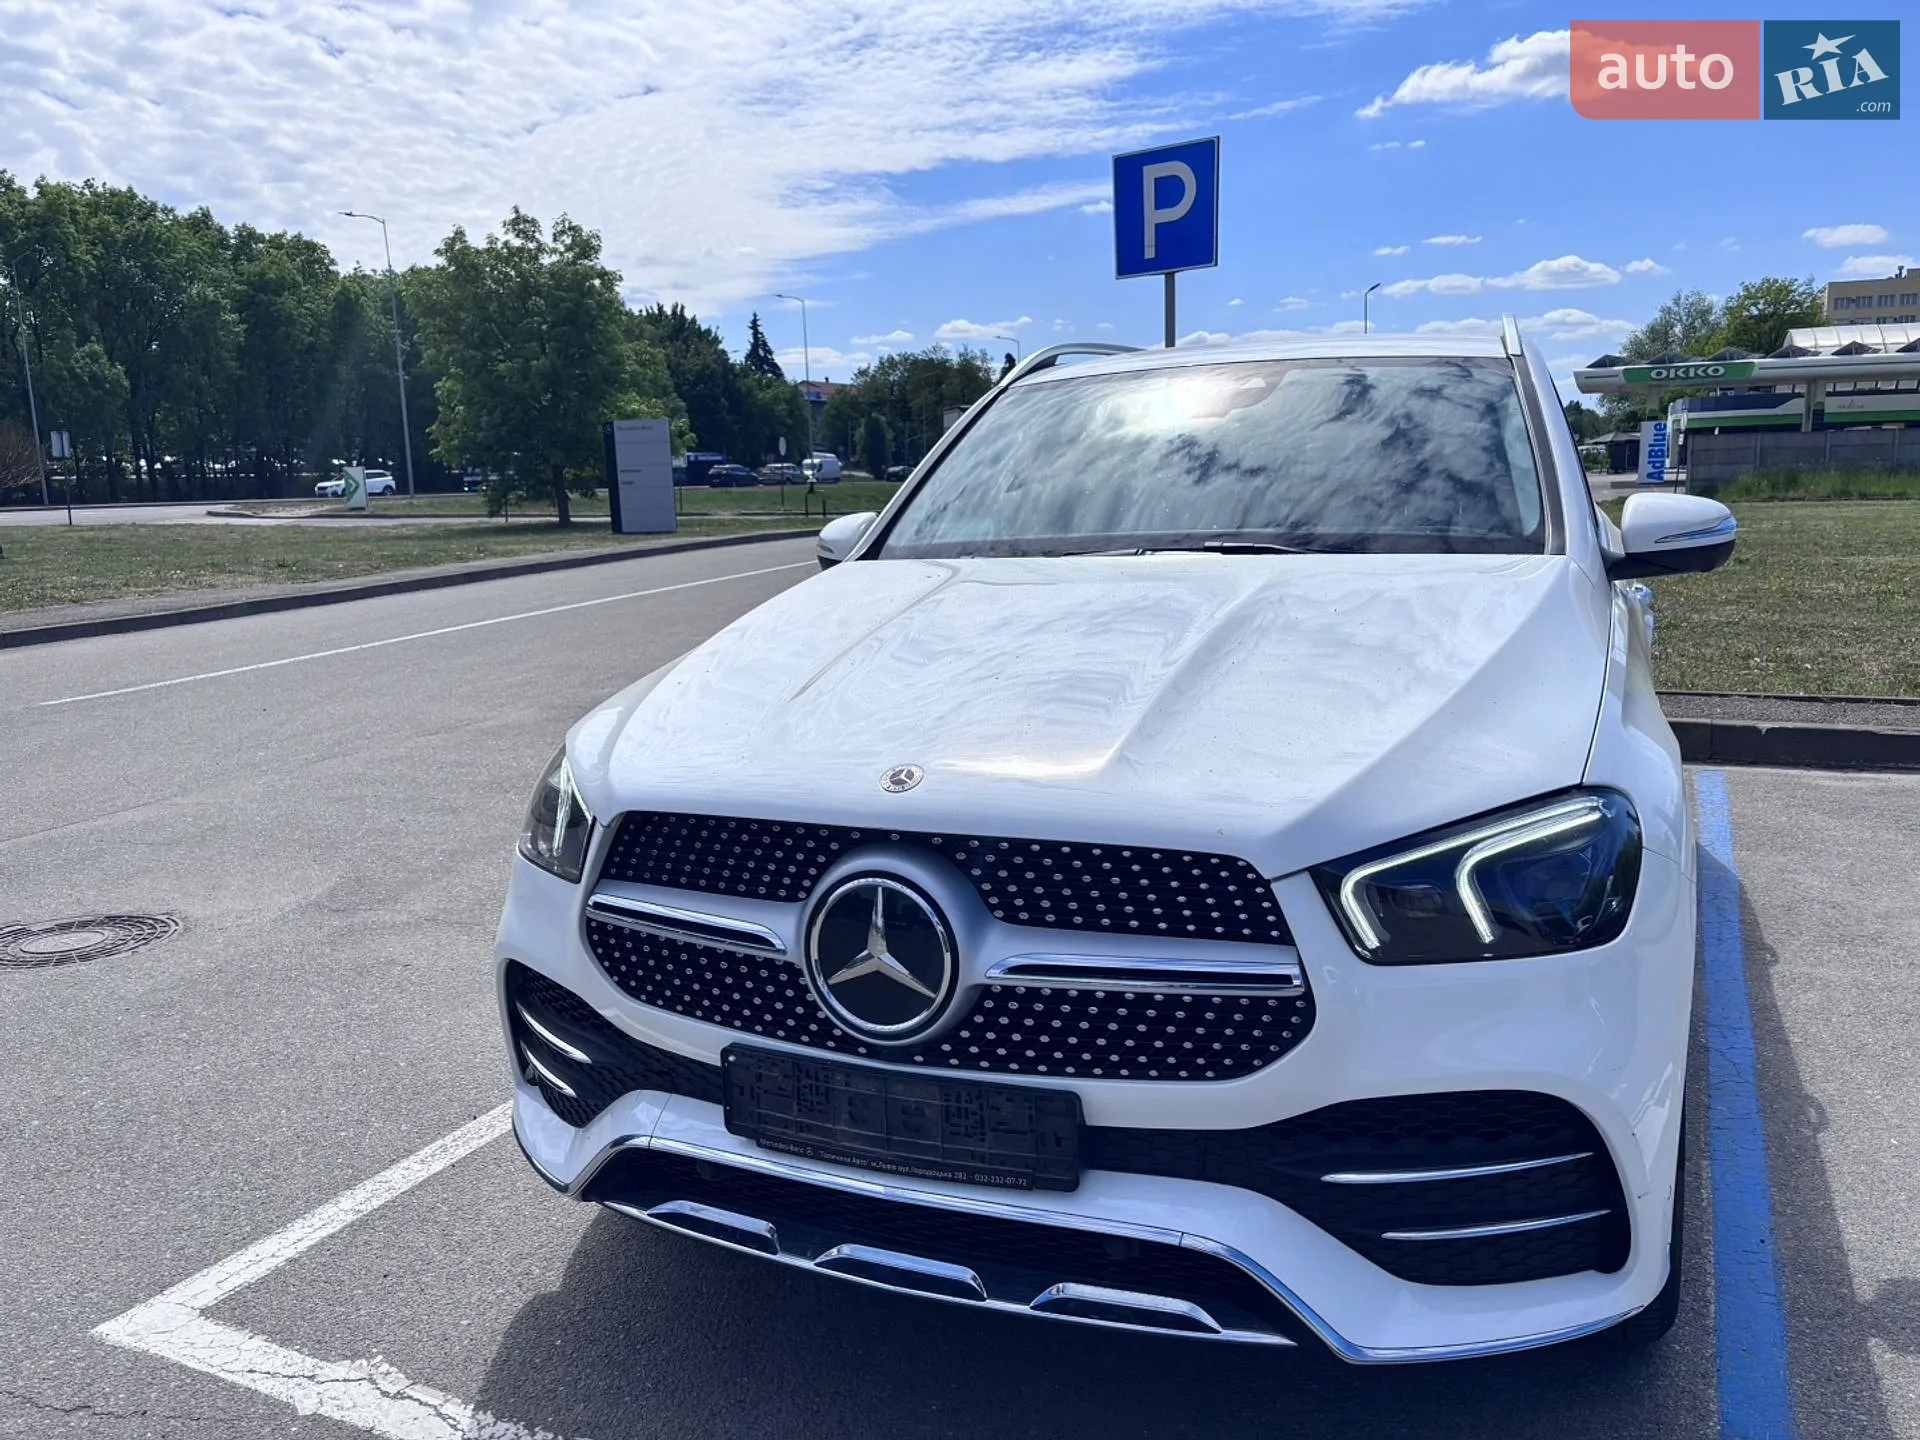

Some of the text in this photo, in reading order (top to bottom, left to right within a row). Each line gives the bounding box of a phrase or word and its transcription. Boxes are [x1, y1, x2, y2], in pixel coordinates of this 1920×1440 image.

[1143, 160, 1197, 259] P
[1650, 365, 1725, 379] OKKO
[1645, 422, 1667, 481] AdBlue
